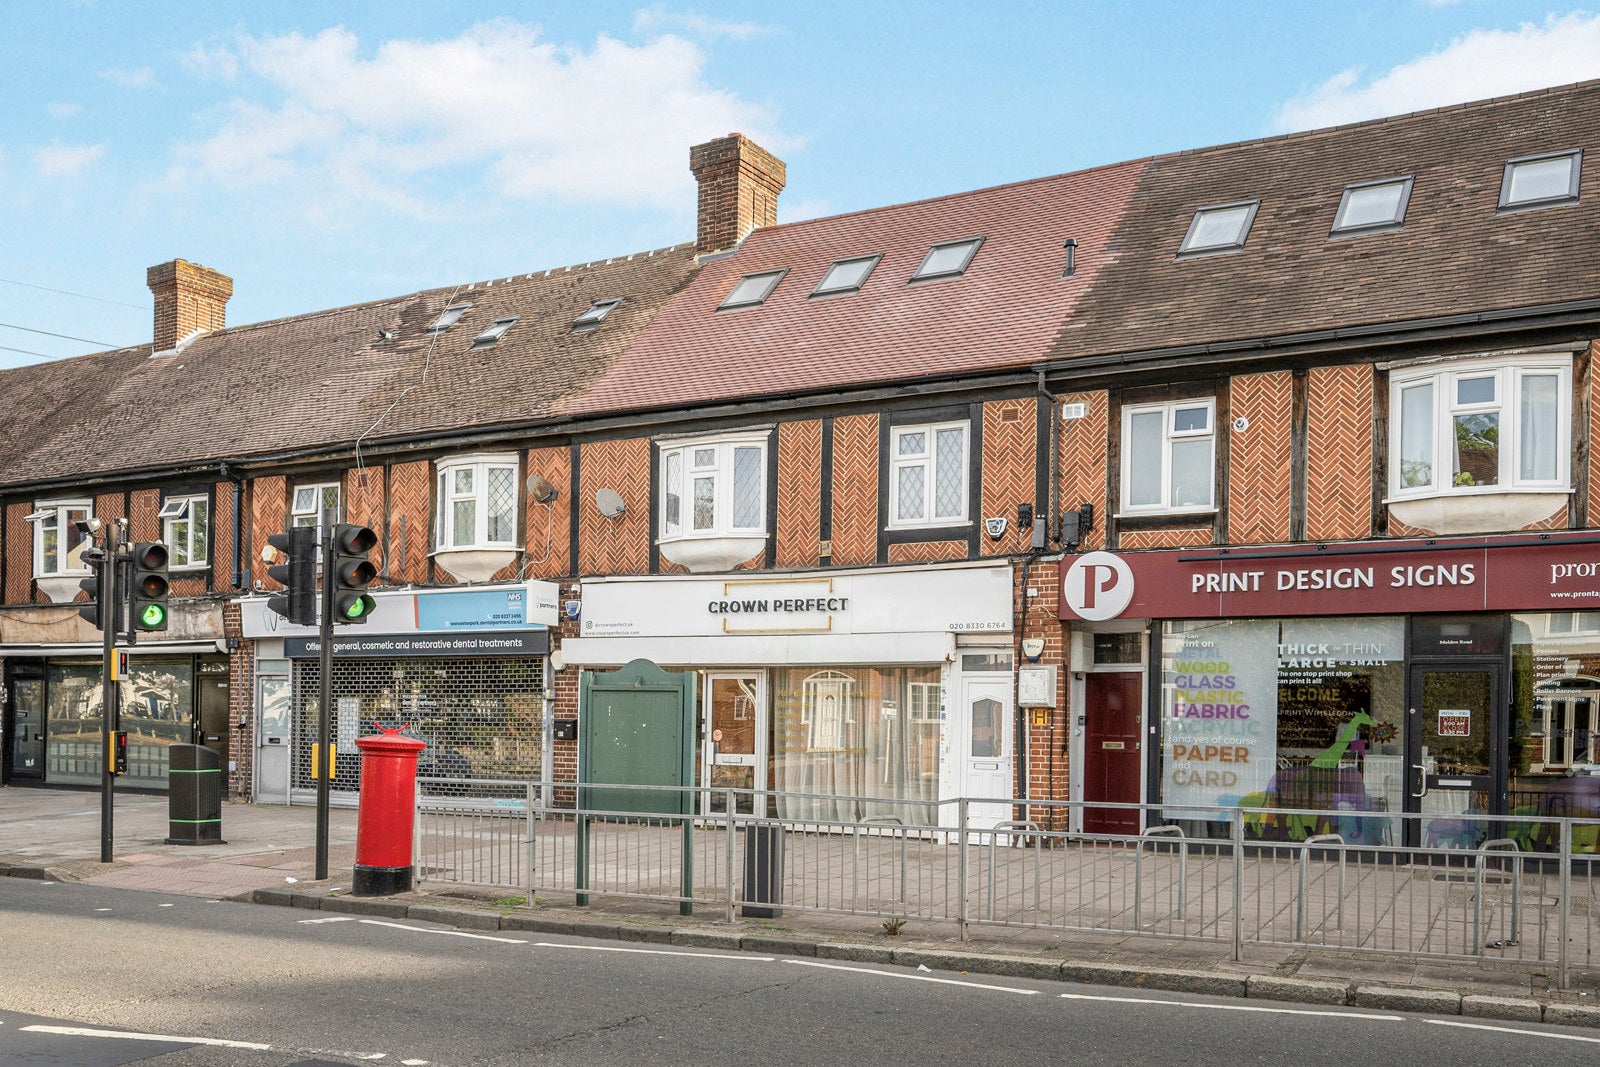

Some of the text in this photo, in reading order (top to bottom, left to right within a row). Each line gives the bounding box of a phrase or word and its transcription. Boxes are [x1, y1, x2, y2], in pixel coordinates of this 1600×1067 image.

[1191, 564, 1476, 593] PRINT DESIGN SIGNS
[1079, 564, 1119, 609] P
[1550, 590, 1600, 599] www.pronta
[539, 602, 558, 610] partners
[708, 598, 849, 614] CROWN PERFECT
[333, 641, 361, 652] general,
[362, 640, 394, 650] cosmetic
[395, 640, 409, 649] and
[411, 639, 451, 649] restorative
[453, 638, 477, 648] dental
[479, 638, 523, 648] treatments
[1278, 643, 1329, 655] THICK
[1343, 643, 1381, 654] THIN
[1175, 661, 1231, 674] WOOD
[1278, 658, 1336, 668] LARGE
[1174, 675, 1236, 689] GLASS
[1174, 690, 1244, 703] PLASTIC
[1278, 688, 1342, 701] ELCOME
[1034, 709, 1047, 724] H
[1174, 703, 1250, 719] FABRIC
[1174, 720, 1261, 735] ACRYLIC
[1172, 735, 1257, 746] and yes of course
[1173, 744, 1249, 763] PAPER
[1172, 761, 1191, 769] and
[1172, 770, 1238, 787] CARD
